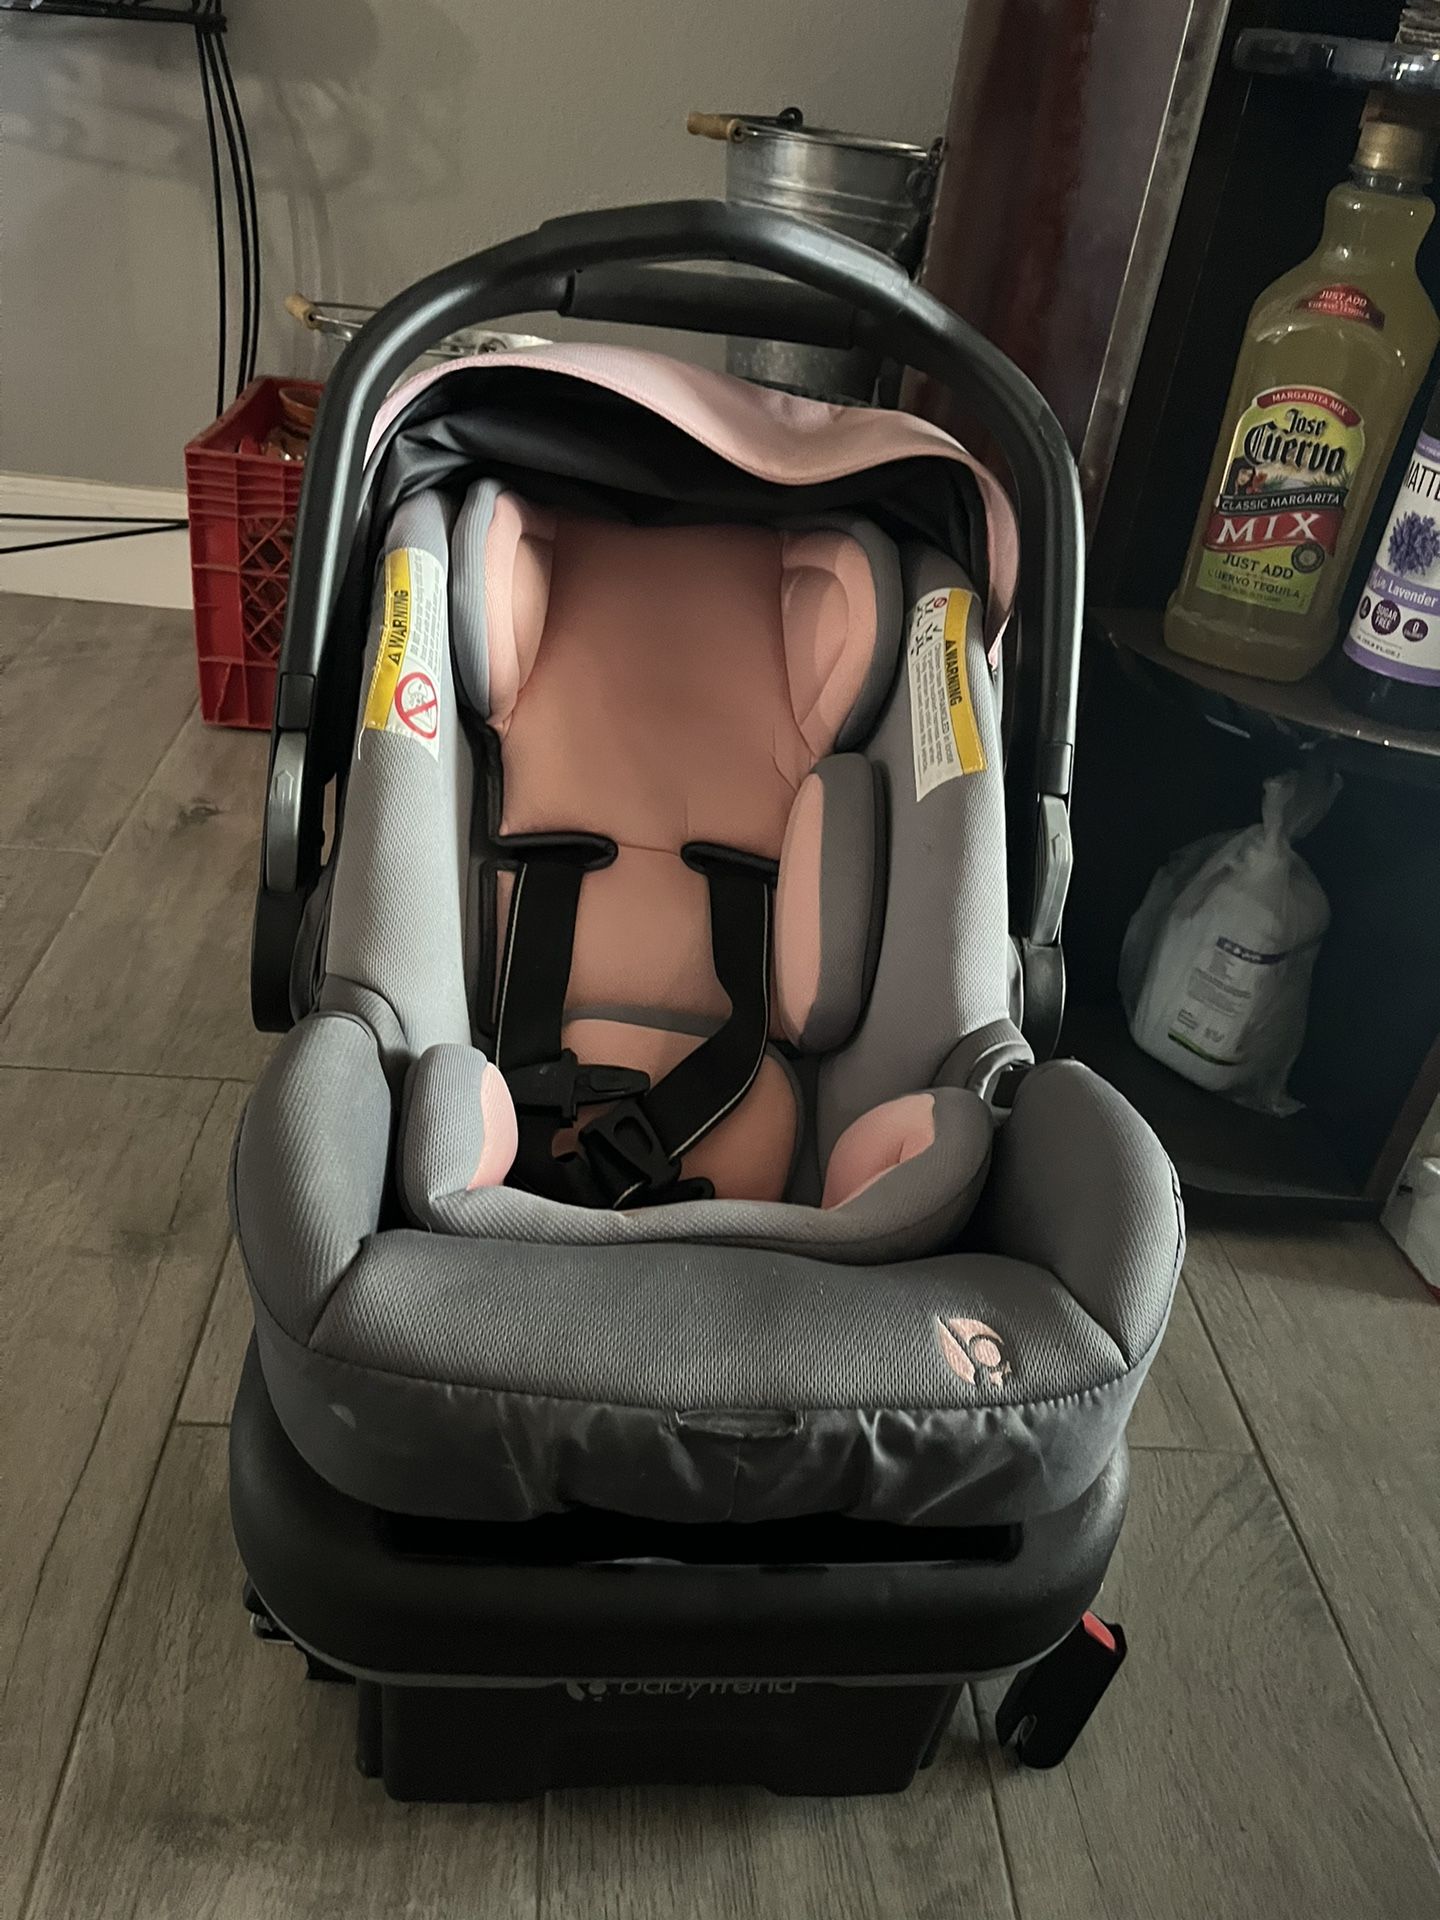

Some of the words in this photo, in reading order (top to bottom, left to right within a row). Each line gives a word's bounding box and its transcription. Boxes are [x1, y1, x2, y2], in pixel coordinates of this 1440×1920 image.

[1320, 290, 1345, 300] JUST
[1346, 295, 1367, 307] ADD
[1272, 390, 1328, 405] MARGARITA
[1329, 400, 1348, 416] MIX
[1243, 420, 1346, 475] Cuervo
[1221, 500, 1270, 511] CLASSIC
[1270, 493, 1340, 508] MARGARITA
[1216, 512, 1321, 544] MIX
[1222, 553, 1260, 571] JUST
[1262, 563, 1294, 580] ADD
[1208, 568, 1250, 588] CUERVO
[1253, 580, 1301, 599] TEQUILA
[1388, 580, 1439, 608] Lavender
[388, 590, 409, 648] WARNING
[1375, 616, 1391, 630] FREE
[1376, 603, 1398, 621] SUGAR
[946, 648, 962, 706] WARNING
